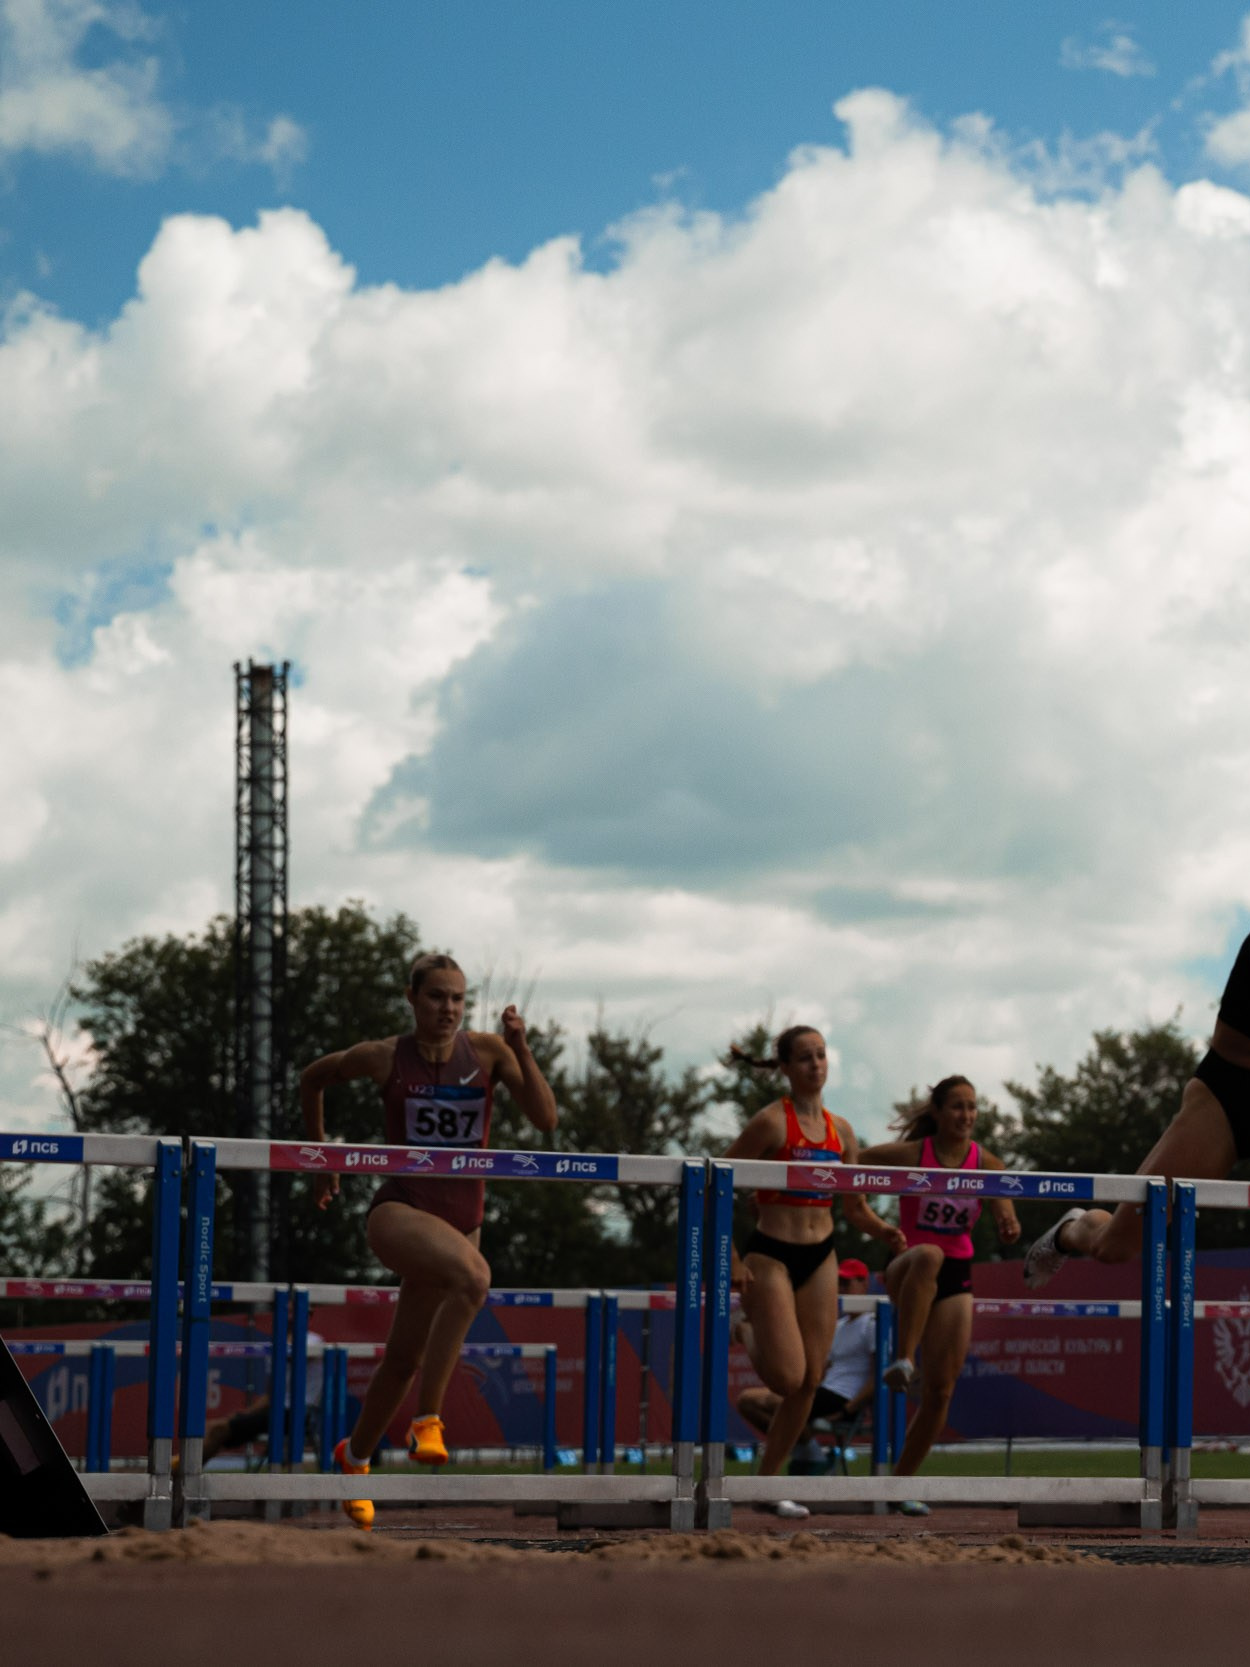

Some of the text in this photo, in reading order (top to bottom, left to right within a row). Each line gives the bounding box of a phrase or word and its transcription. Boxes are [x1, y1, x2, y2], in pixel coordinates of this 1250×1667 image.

[415, 1107, 479, 1138] 587
[30, 1142, 59, 1154] ПСБ
[362, 1154, 389, 1165] ПСБ
[468, 1157, 494, 1169] ПСБ
[572, 1161, 597, 1173] ПСБ
[868, 1175, 891, 1186] ПСБ
[961, 1178, 984, 1189] ПСБ
[1053, 1181, 1075, 1193] ПСБ
[923, 1202, 969, 1224] 596
[198, 1264, 209, 1303] Sport
[689, 1271, 699, 1308] Sport
[718, 1279, 728, 1318] Sport
[1155, 1286, 1164, 1321] Sport
[1183, 1292, 1192, 1328] Sport
